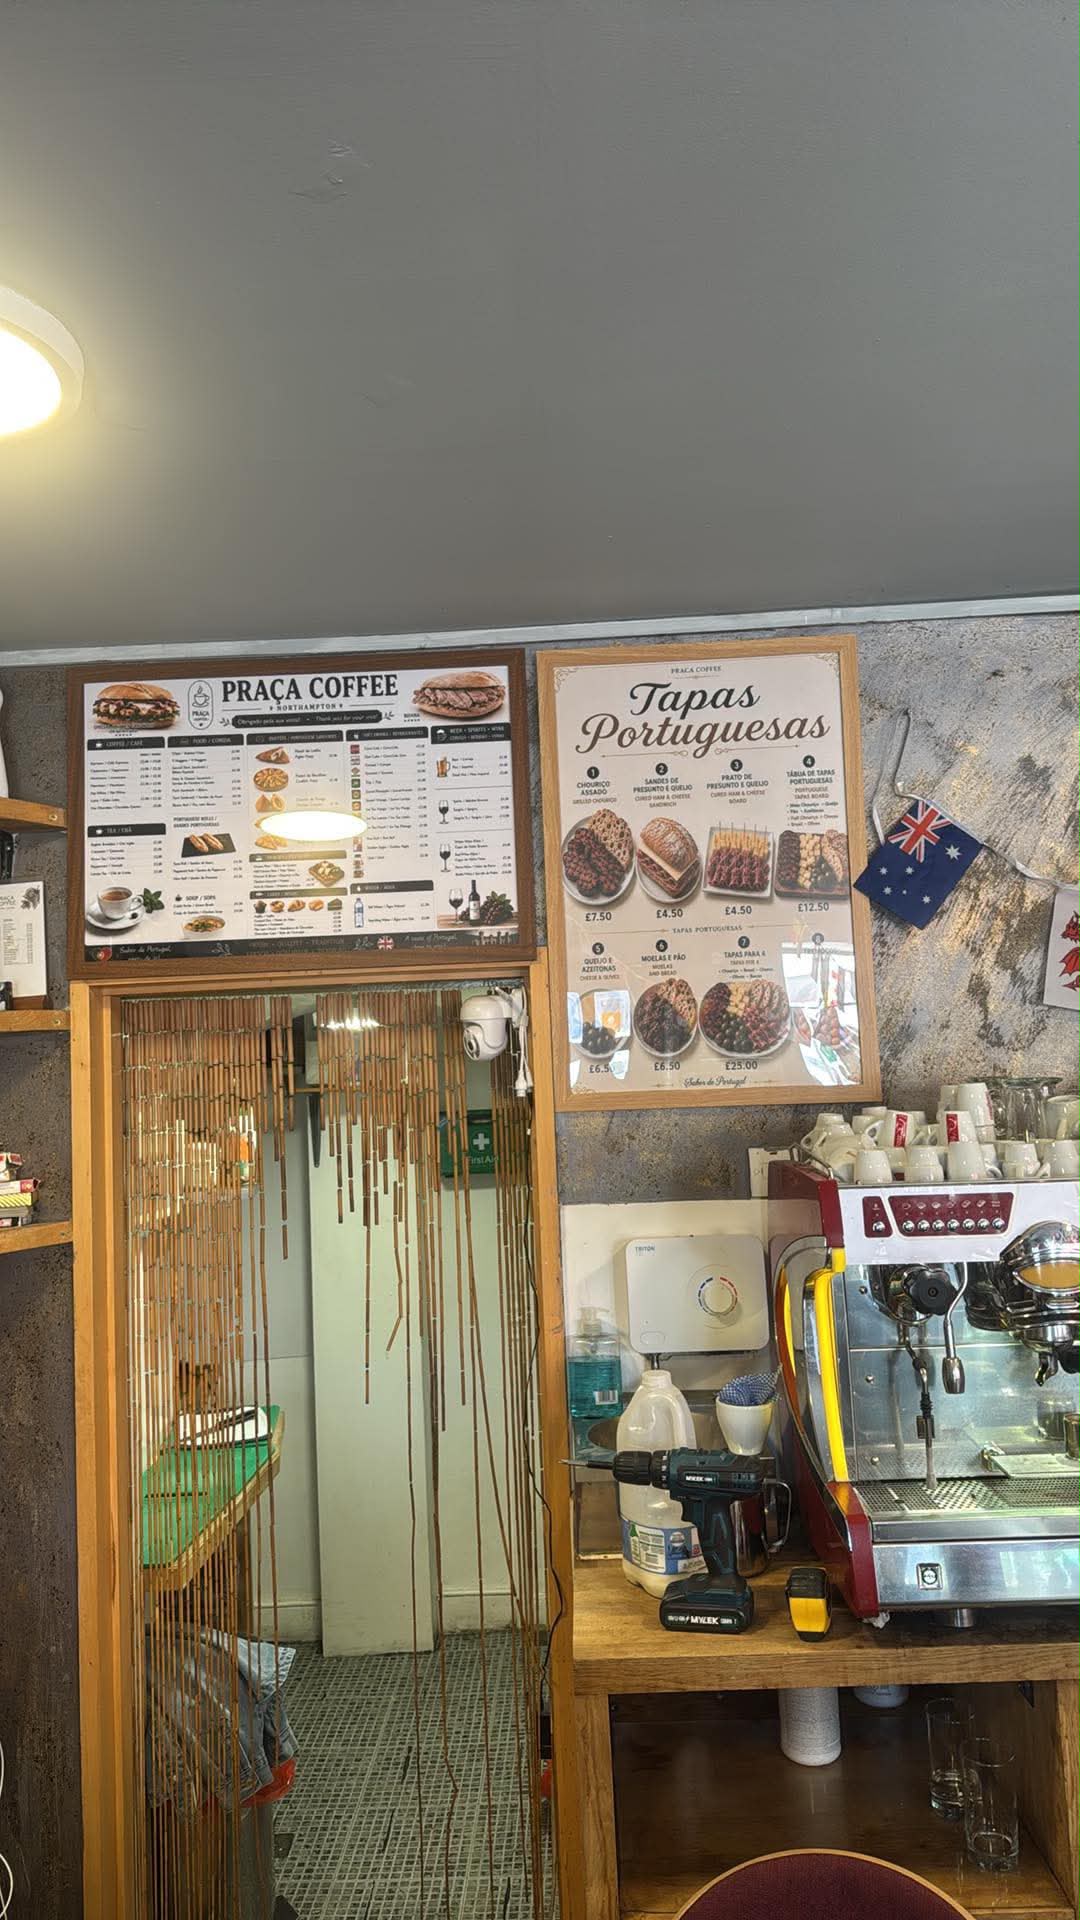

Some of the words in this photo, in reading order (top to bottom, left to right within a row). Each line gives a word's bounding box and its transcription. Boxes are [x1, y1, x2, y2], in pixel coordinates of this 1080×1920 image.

[222, 678, 302, 705] PRAÇA
[309, 674, 398, 699] COFFEE
[630, 682, 760, 720] Tapas
[276, 703, 336, 712] NORTHAMPTON
[575, 713, 831, 759] Portuguesas
[576, 780, 610, 788] CHOURIÇO
[790, 776, 833, 785] PORTUGUESAS
[725, 906, 752, 916] £4.50
[798, 902, 830, 912] £12.50
[585, 912, 612, 922] £7.50
[656, 909, 684, 918] £4.50
[582, 965, 616, 973] AZEITONAS
[654, 1060, 681, 1071] £6.50
[725, 1060, 758, 1070] £25.00
[715, 1075, 747, 1088] Portugal
[690, 1616, 719, 1625] MYLEK
